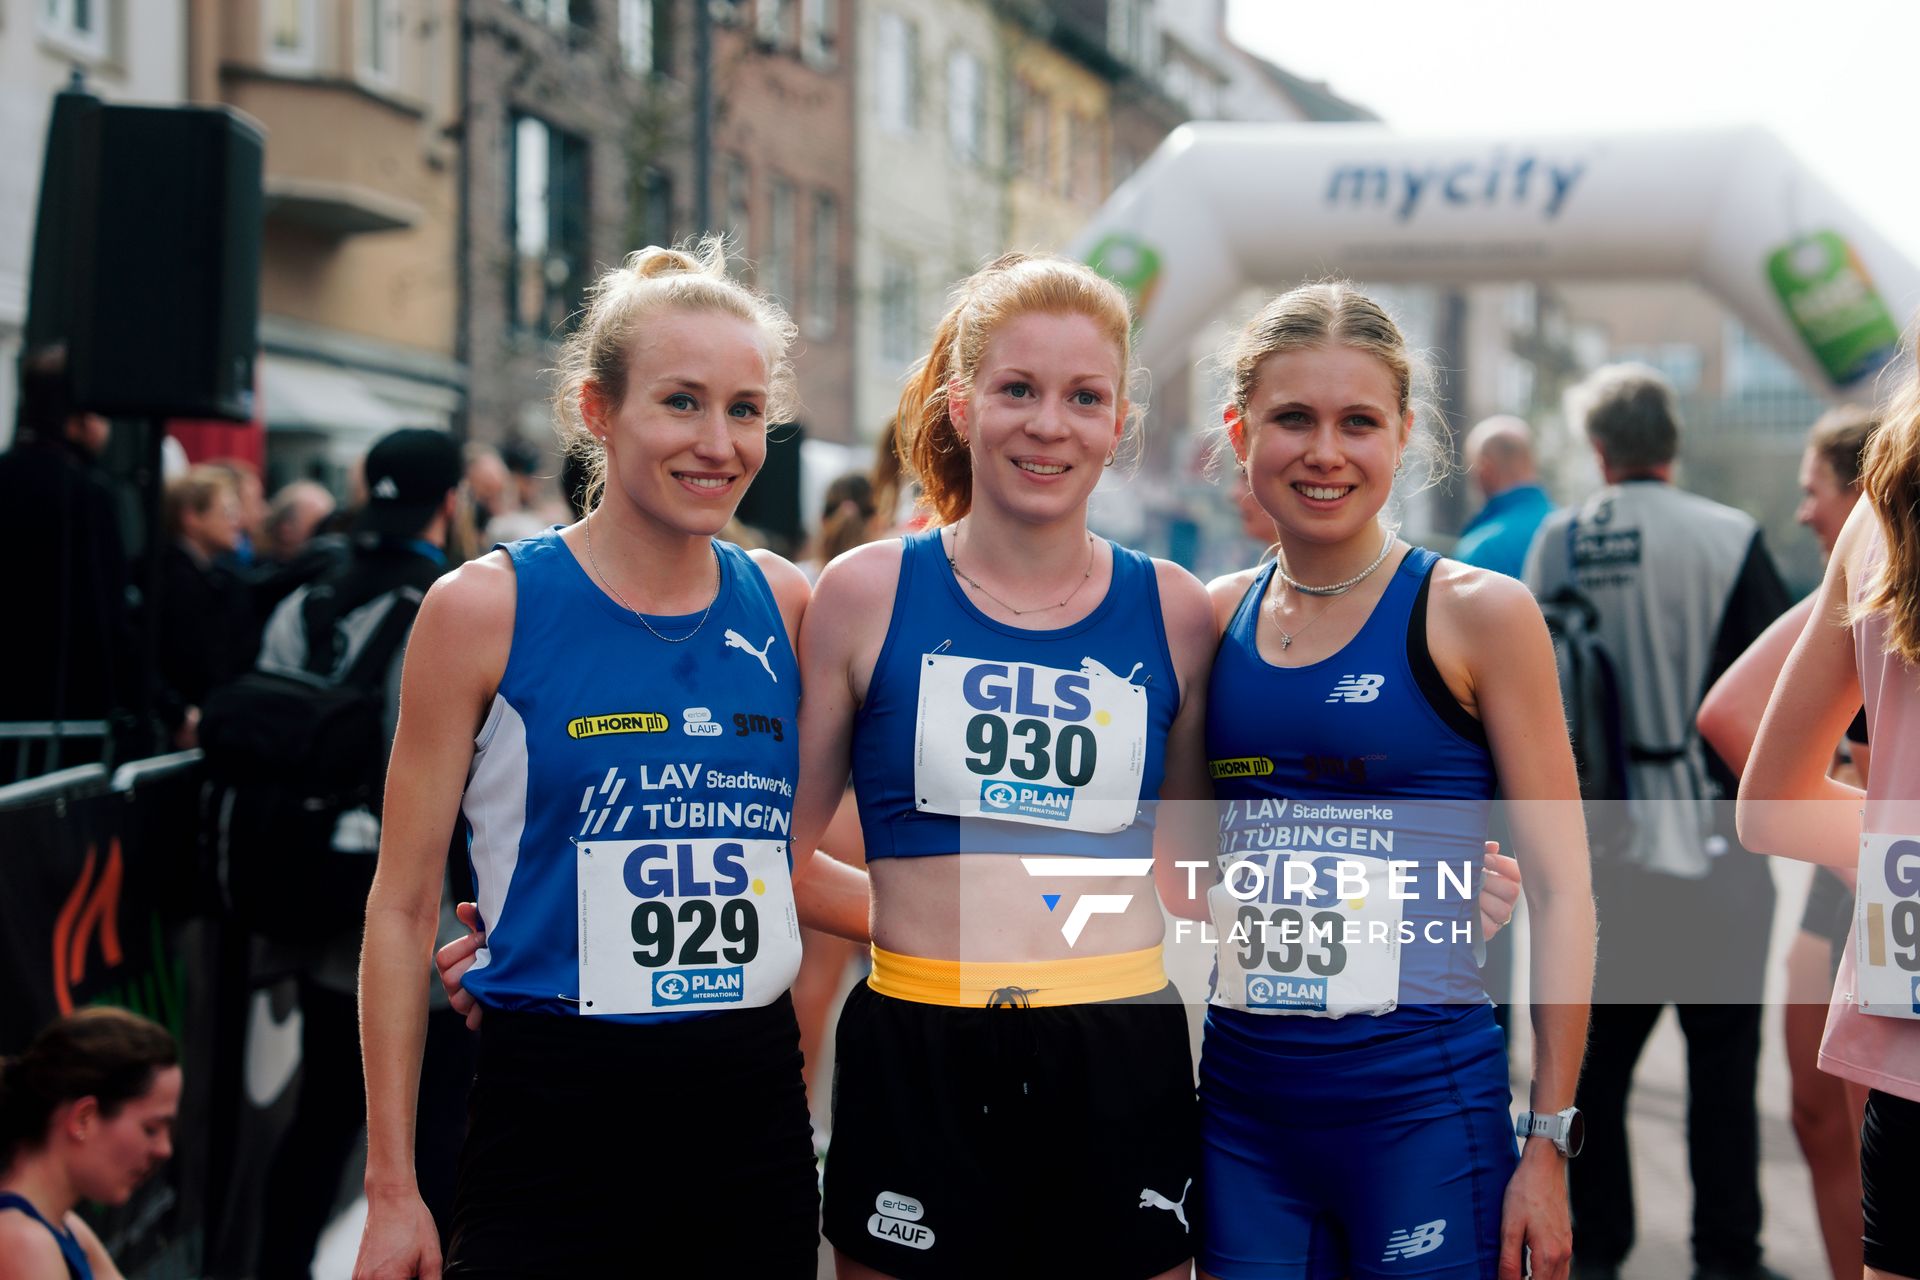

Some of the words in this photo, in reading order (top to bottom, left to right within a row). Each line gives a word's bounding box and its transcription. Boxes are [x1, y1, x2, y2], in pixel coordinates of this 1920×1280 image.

[1326, 146, 1586, 221] mycity
[598, 717, 643, 731] HORN
[690, 724, 718, 734] LAUF
[733, 713, 784, 742] gmg
[965, 713, 1097, 787] 930
[1218, 760, 1251, 775] HORN
[640, 763, 702, 790] LAV
[706, 770, 792, 797] Stadtwerke
[1020, 788, 1070, 810] PLAN
[1245, 798, 1288, 820] LAV
[1292, 804, 1393, 821] Stadtwerke
[643, 796, 791, 836] TÜBINGEN
[1018, 805, 1067, 817] INTERNATIONAL
[1244, 823, 1394, 852] TÜBINGEN
[630, 898, 759, 968] 929
[1236, 905, 1347, 977] 933
[692, 973, 741, 991] PLAN
[1276, 982, 1324, 999] PLAN
[692, 991, 740, 999] INTERNATIONAL
[882, 1198, 918, 1214] erbe
[875, 1217, 929, 1245] LAUF
